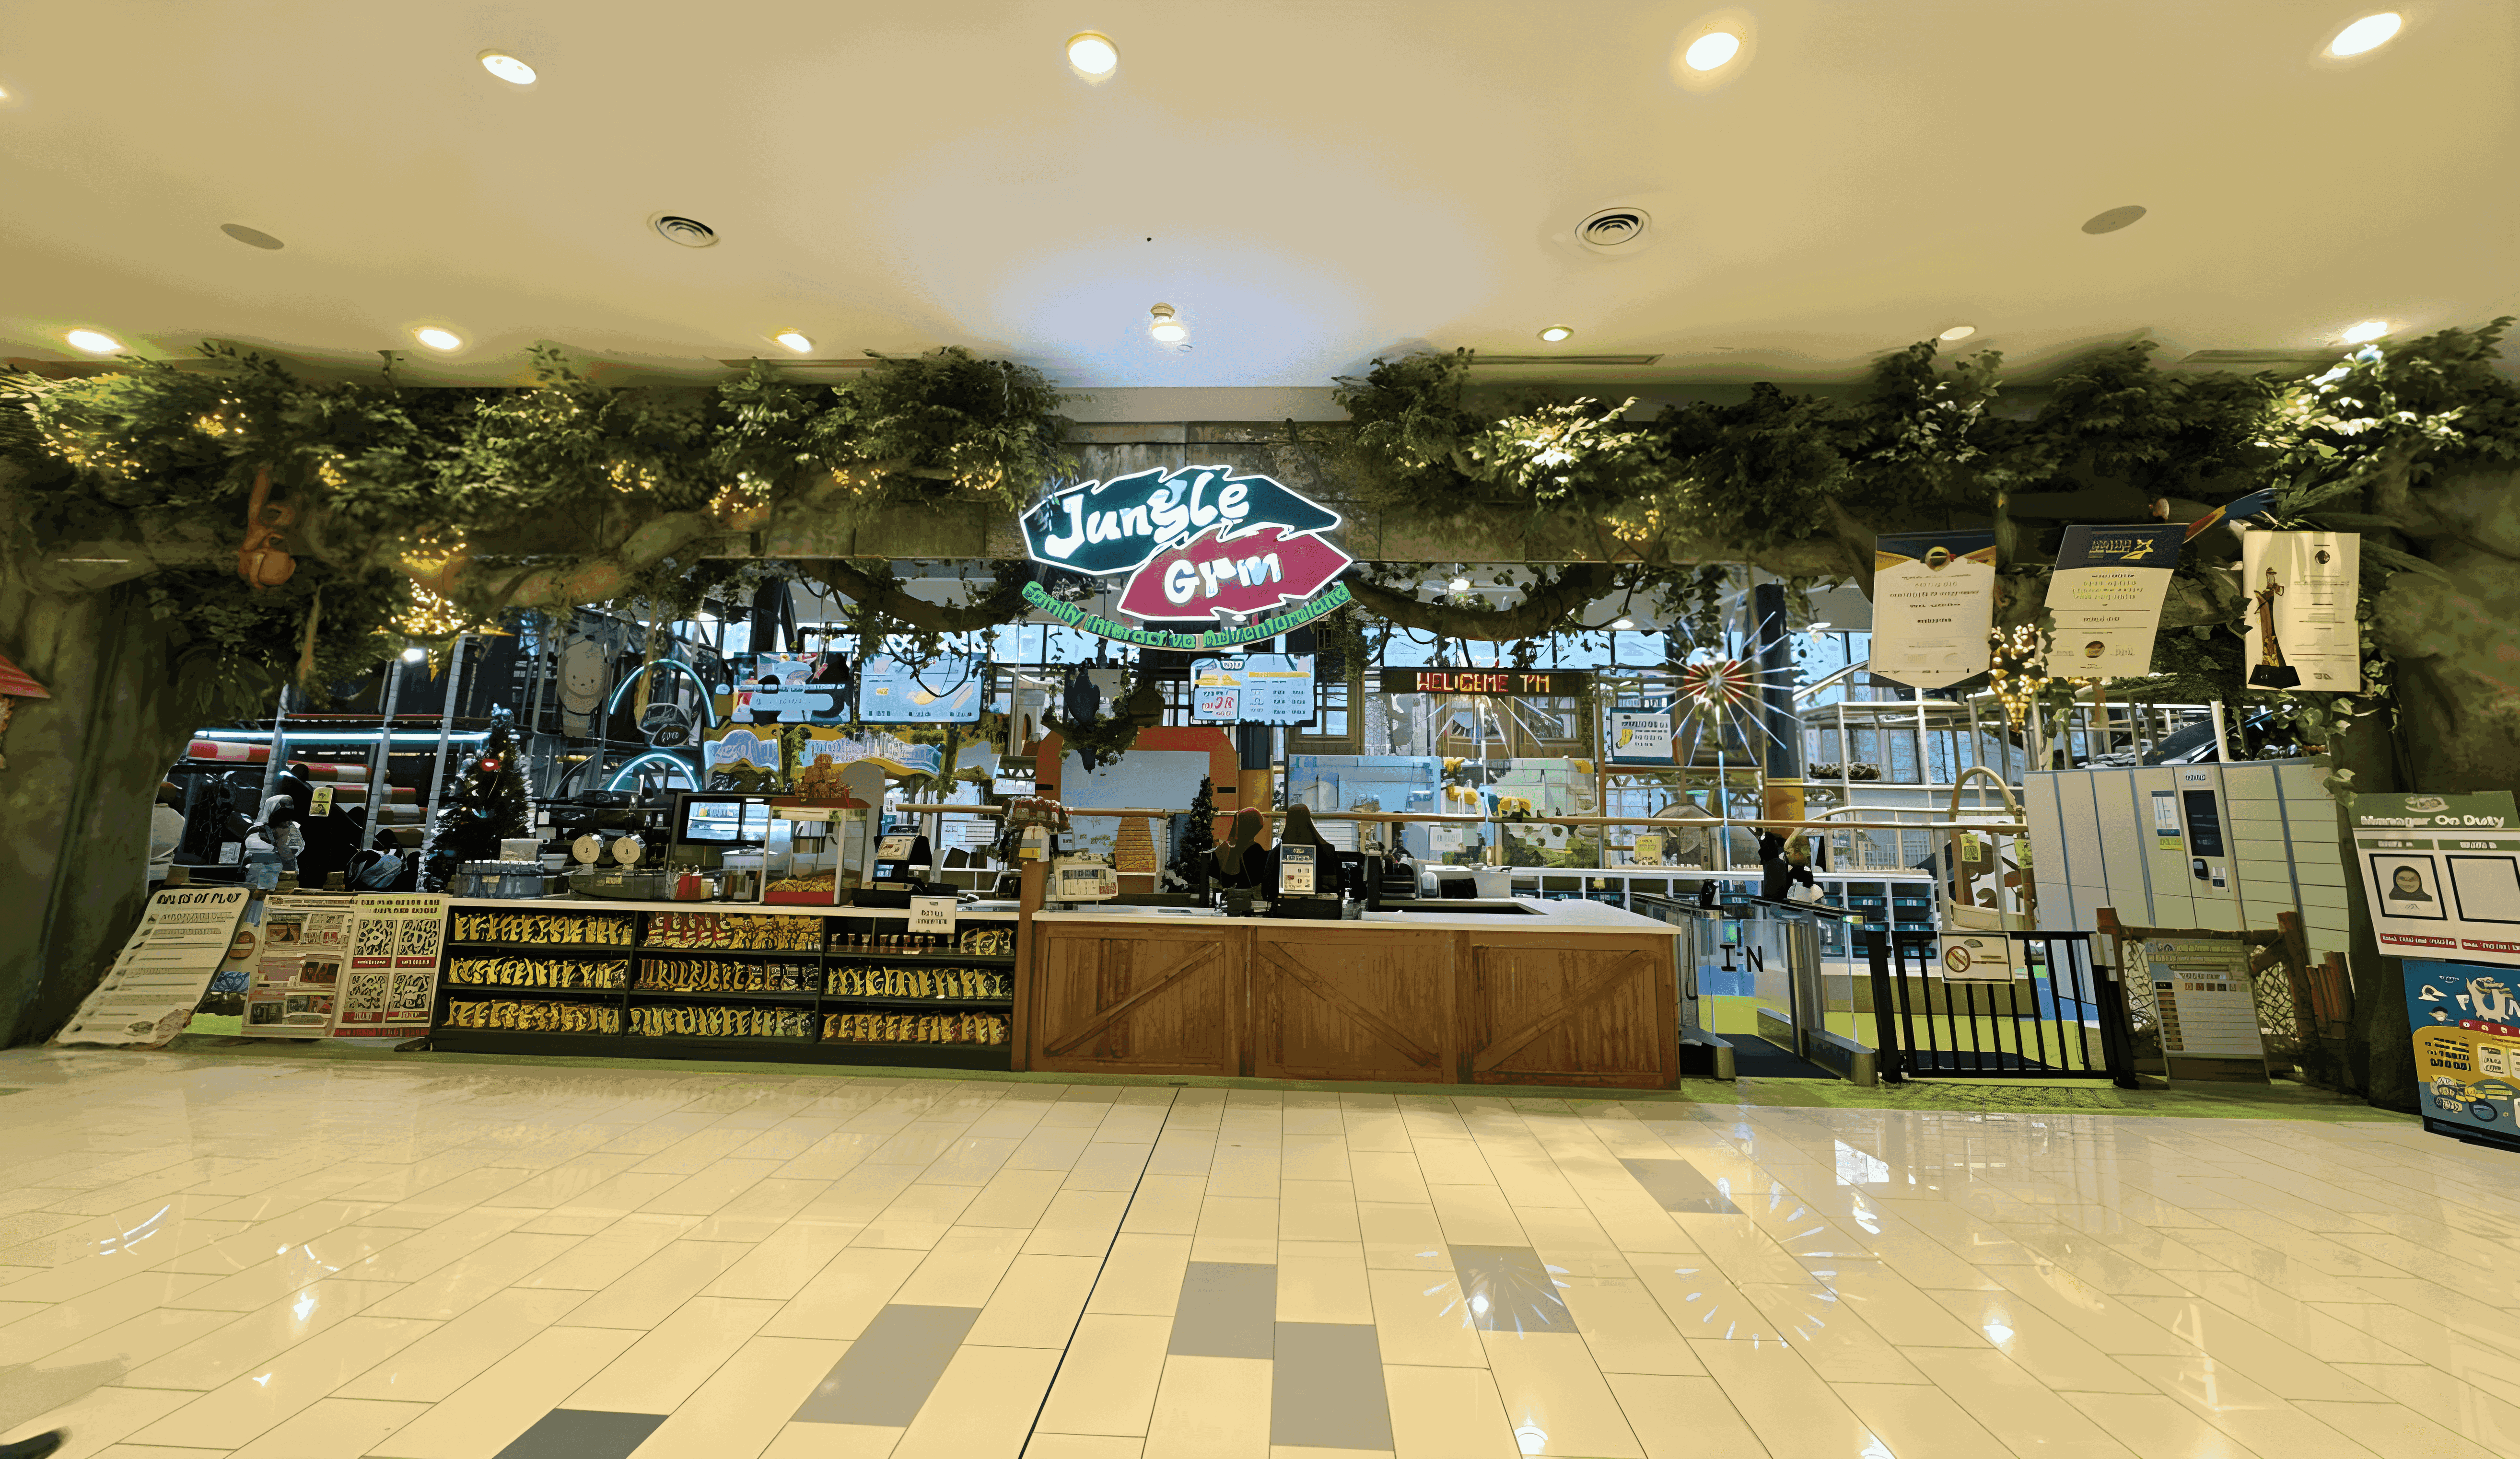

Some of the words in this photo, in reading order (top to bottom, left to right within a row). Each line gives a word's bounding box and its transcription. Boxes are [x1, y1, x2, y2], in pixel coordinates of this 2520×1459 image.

[1045, 472, 1249, 558] Jungle
[1164, 553, 1283, 603] Gym
[2360, 815, 2431, 828] Manager
[2435, 815, 2460, 826] On
[2463, 815, 2505, 828] Duty
[1719, 944, 1763, 973] IN
